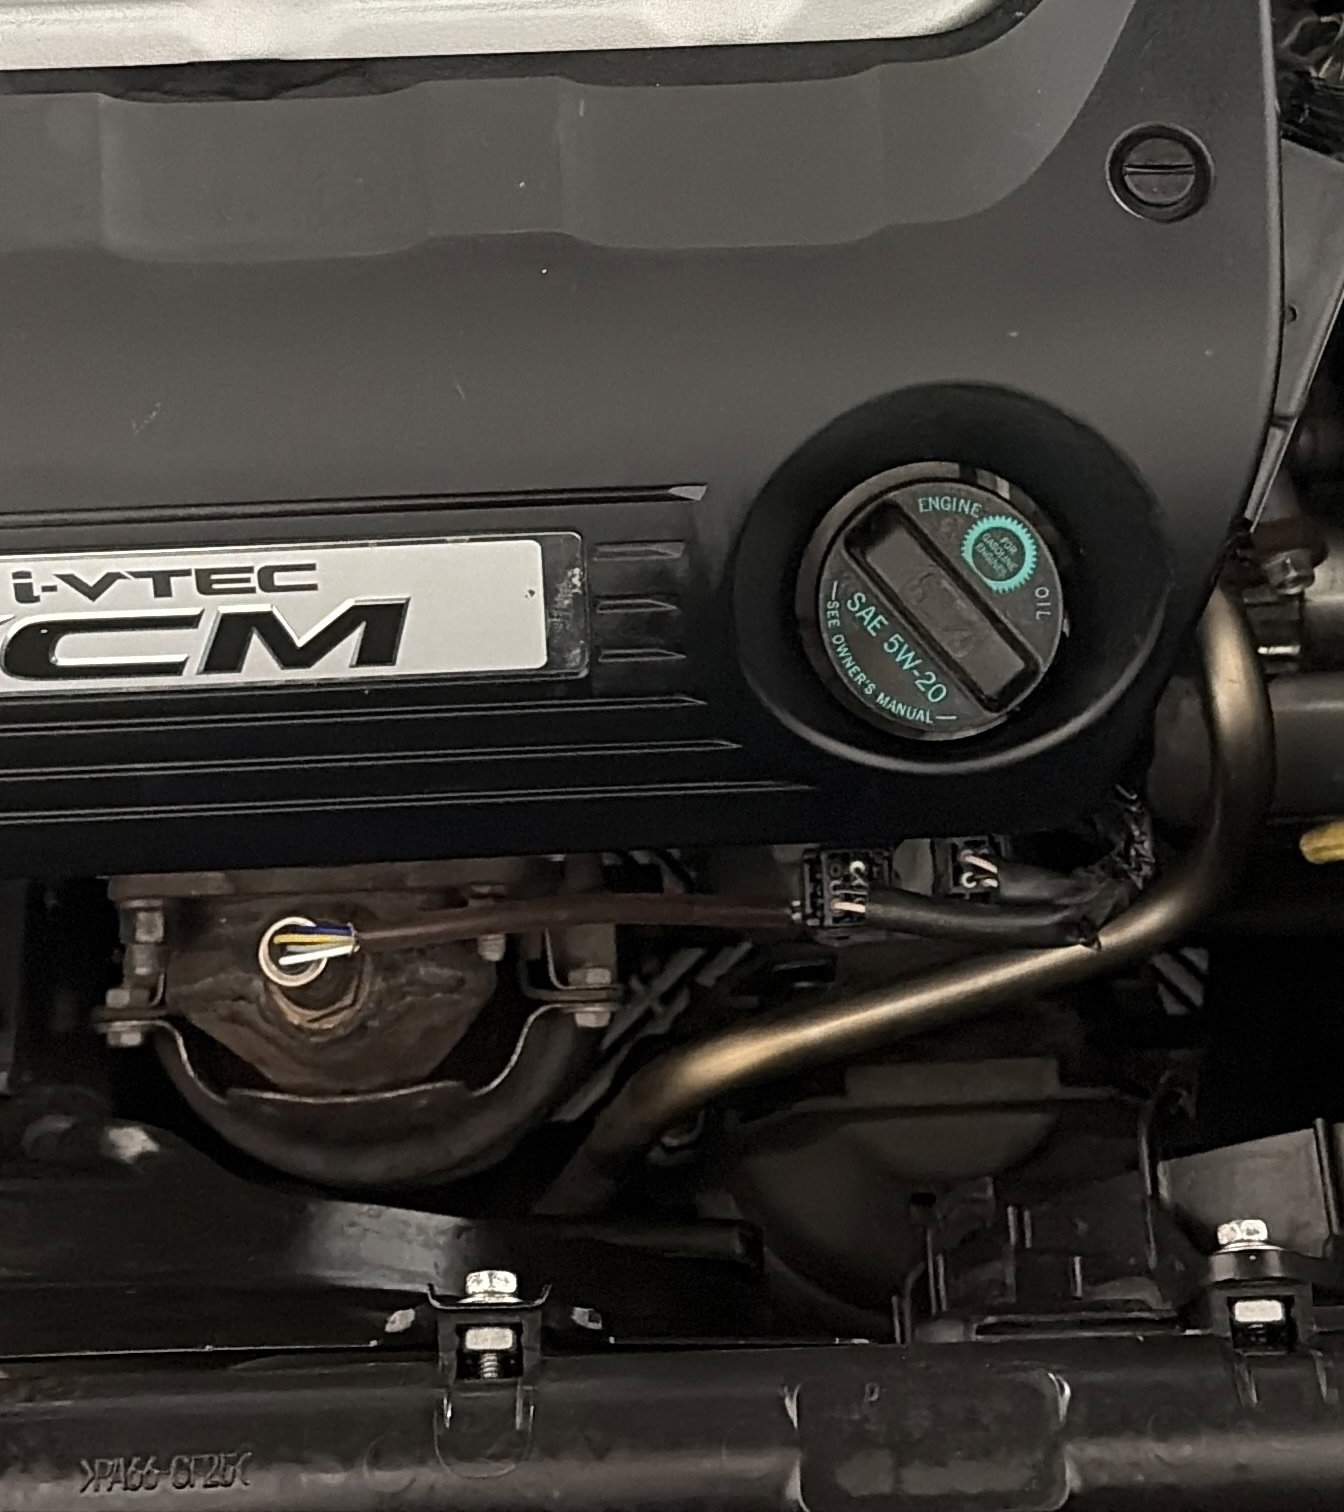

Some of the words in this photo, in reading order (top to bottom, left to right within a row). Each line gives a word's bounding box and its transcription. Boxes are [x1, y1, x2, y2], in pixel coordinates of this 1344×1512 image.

[918, 496, 983, 518] ENGINE
[10, 562, 319, 604] i-VTEC
[827, 601, 840, 628] SEE
[1035, 587, 1051, 620] OIL
[847, 592, 889, 637] SAE
[883, 633, 947, 703] 5W-20
[832, 634, 876, 695] OWNER'S
[876, 692, 934, 724] MANUAL
